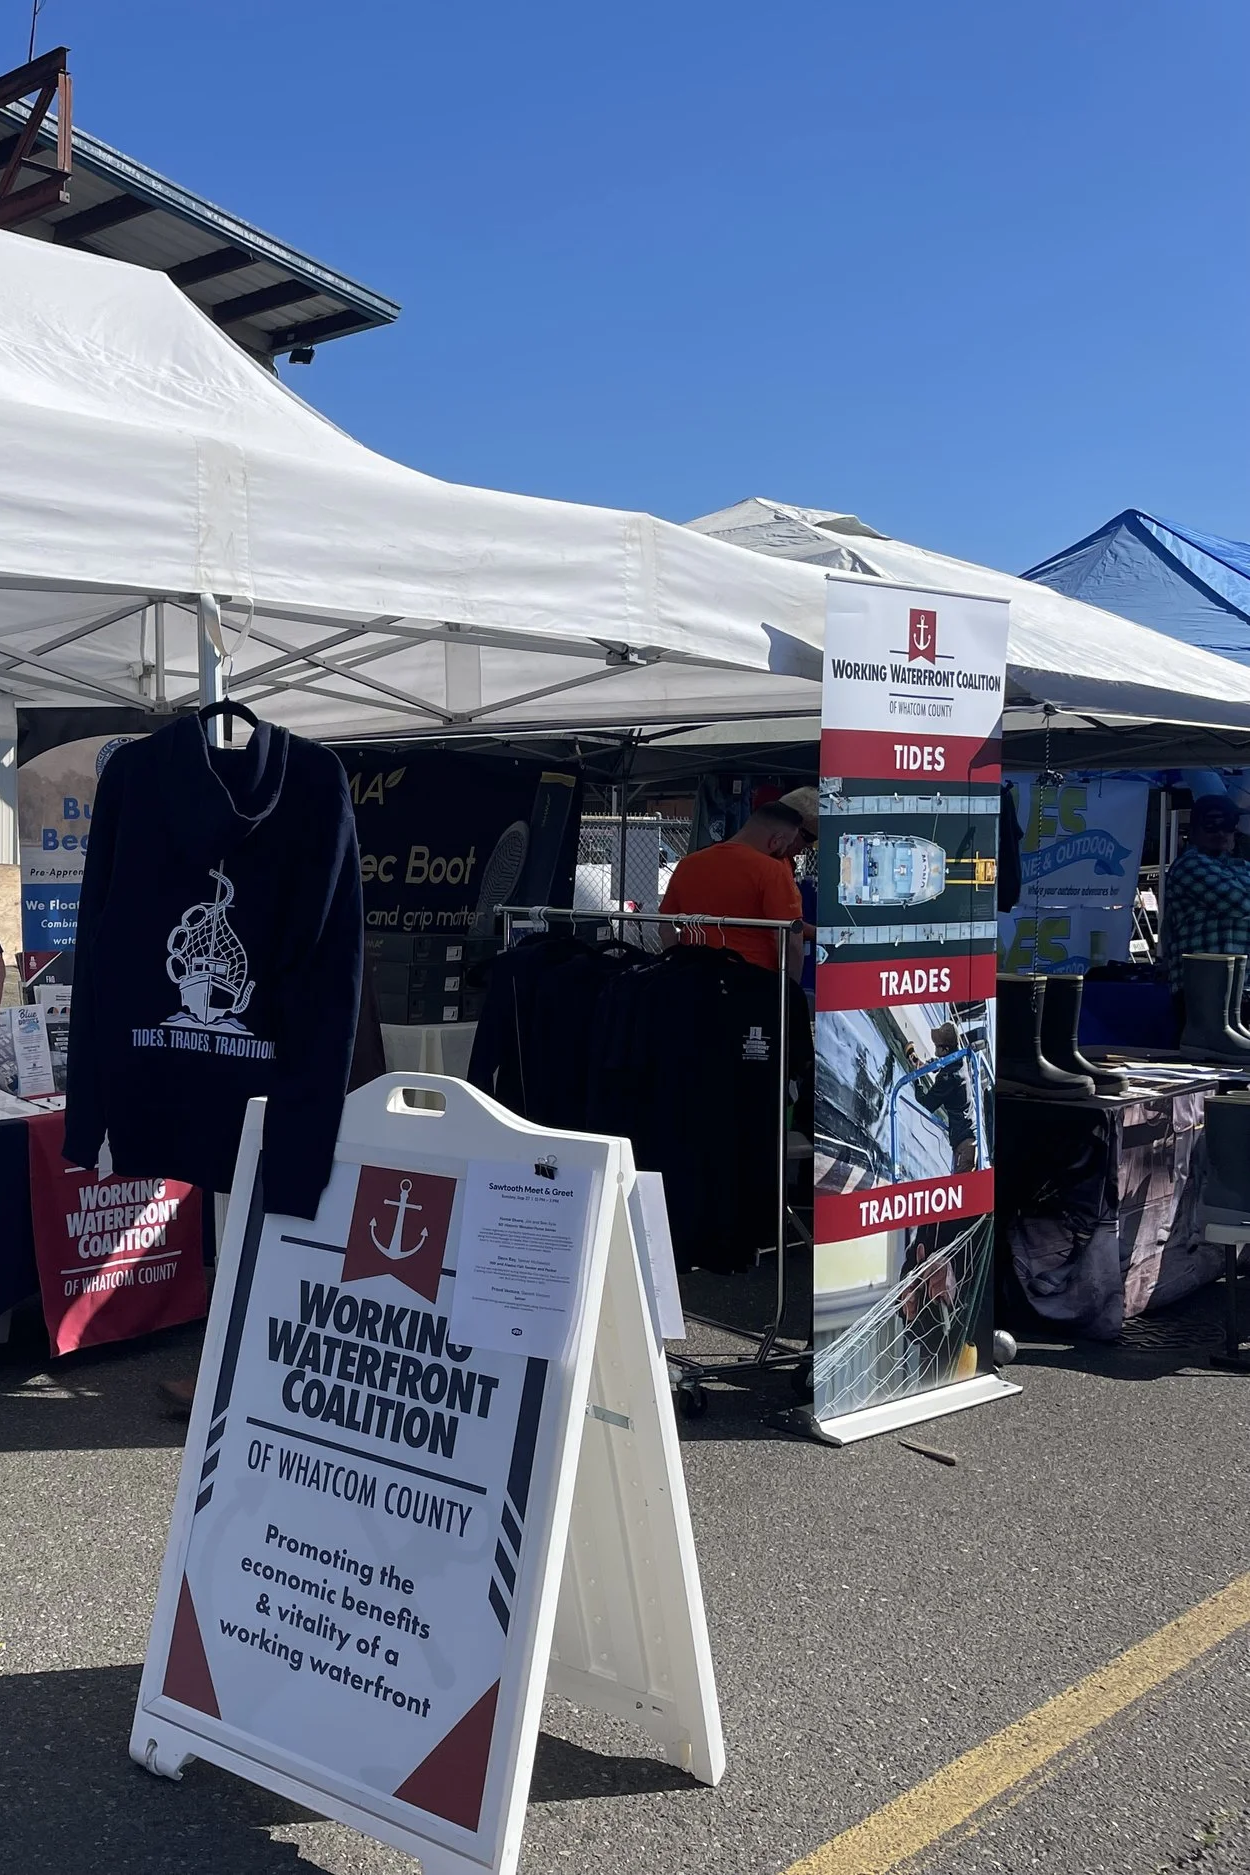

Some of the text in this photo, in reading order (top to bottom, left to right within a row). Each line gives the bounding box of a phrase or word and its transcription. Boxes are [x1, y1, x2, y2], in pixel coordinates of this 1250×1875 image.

[831, 658, 1001, 692] WORKING WATERFRONT COALITION
[889, 700, 953, 718] OF WHATCOM COUNTY
[893, 744, 946, 772] TIDES
[359, 845, 477, 885] ec Boot
[1055, 835, 1115, 863] OUTDOOR
[25, 900, 46, 911] We
[366, 905, 400, 927] and
[403, 907, 433, 931] grip
[879, 967, 951, 997] TRADES
[131, 1028, 167, 1048] TIDES.
[169, 1029, 212, 1053] TRADES.
[78, 1177, 167, 1211] WORKING
[488, 1182, 574, 1198] Sawtooth Meet & Greet
[859, 1184, 963, 1228] TRADITION
[65, 1198, 180, 1239] WATERFRONT
[77, 1224, 167, 1259] COALITION
[63, 1262, 178, 1297] OF WHATCOM COUNTY
[266, 1316, 500, 1420] WATERFRONT
[281, 1368, 460, 1460] COALITION
[246, 1438, 473, 1538] OF WHATCOM COUNTY
[264, 1523, 416, 1596] Promoting the
[240, 1556, 432, 1640] economic benefits
[254, 1592, 400, 1667] & vitality of a
[219, 1618, 432, 1718] working waterfront
